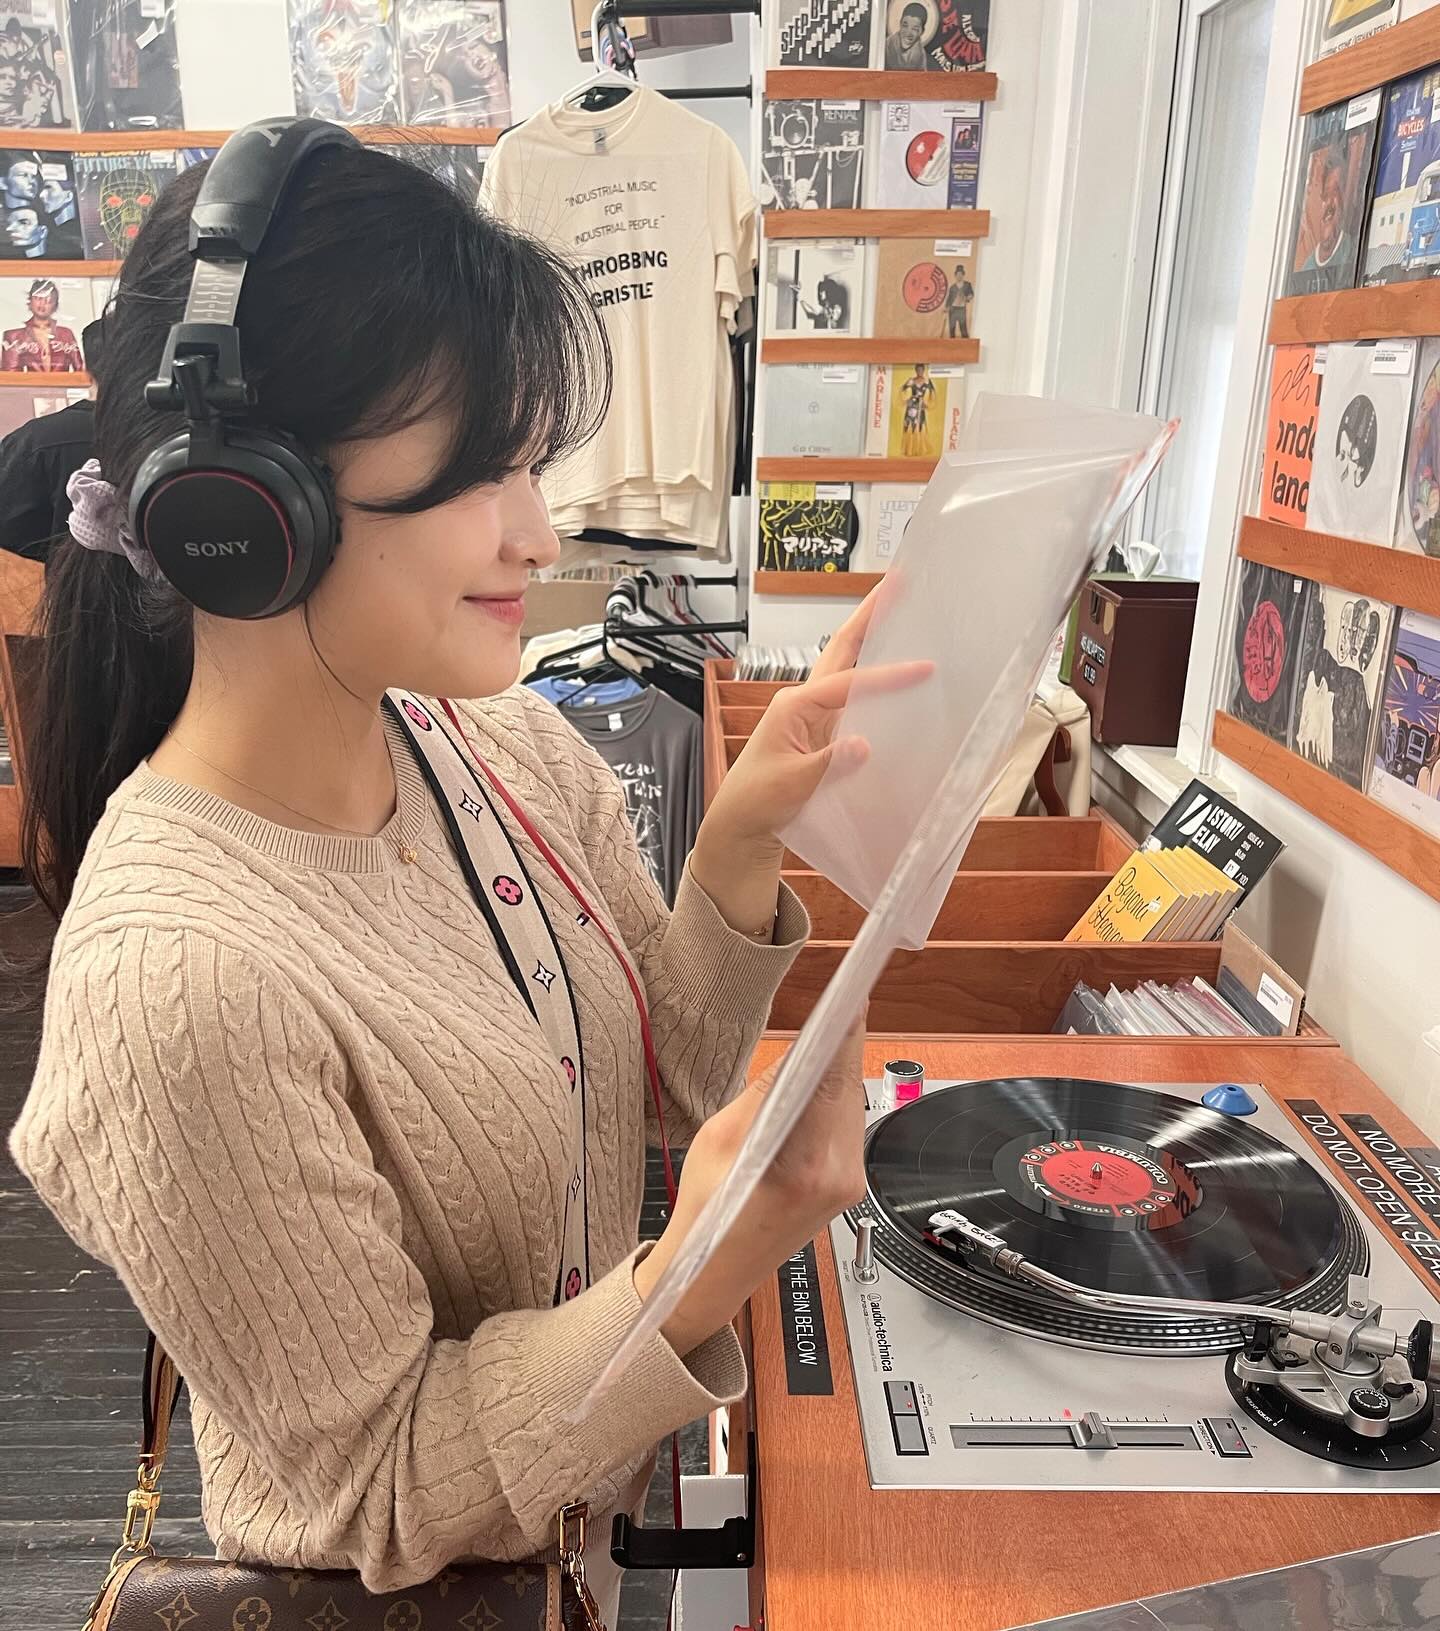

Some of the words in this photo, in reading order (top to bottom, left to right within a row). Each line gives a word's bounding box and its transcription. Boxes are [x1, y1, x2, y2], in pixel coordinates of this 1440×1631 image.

[626, 180, 658, 193] MUSIC
[603, 202, 624, 216] FOR
[590, 282, 654, 308] GRISTLE
[184, 540, 250, 557] SONY
[1358, 1130, 1397, 1153] NO
[1382, 1156, 1440, 1206] MORE
[1301, 1114, 1339, 1137] DO
[1323, 1140, 1373, 1174] NOT
[1356, 1176, 1419, 1226] OPEN
[1401, 1230, 1440, 1280] SEA
[789, 1264, 809, 1289] THE
[795, 1316, 818, 1366] BELOW
[869, 1302, 894, 1372] audio-technica
